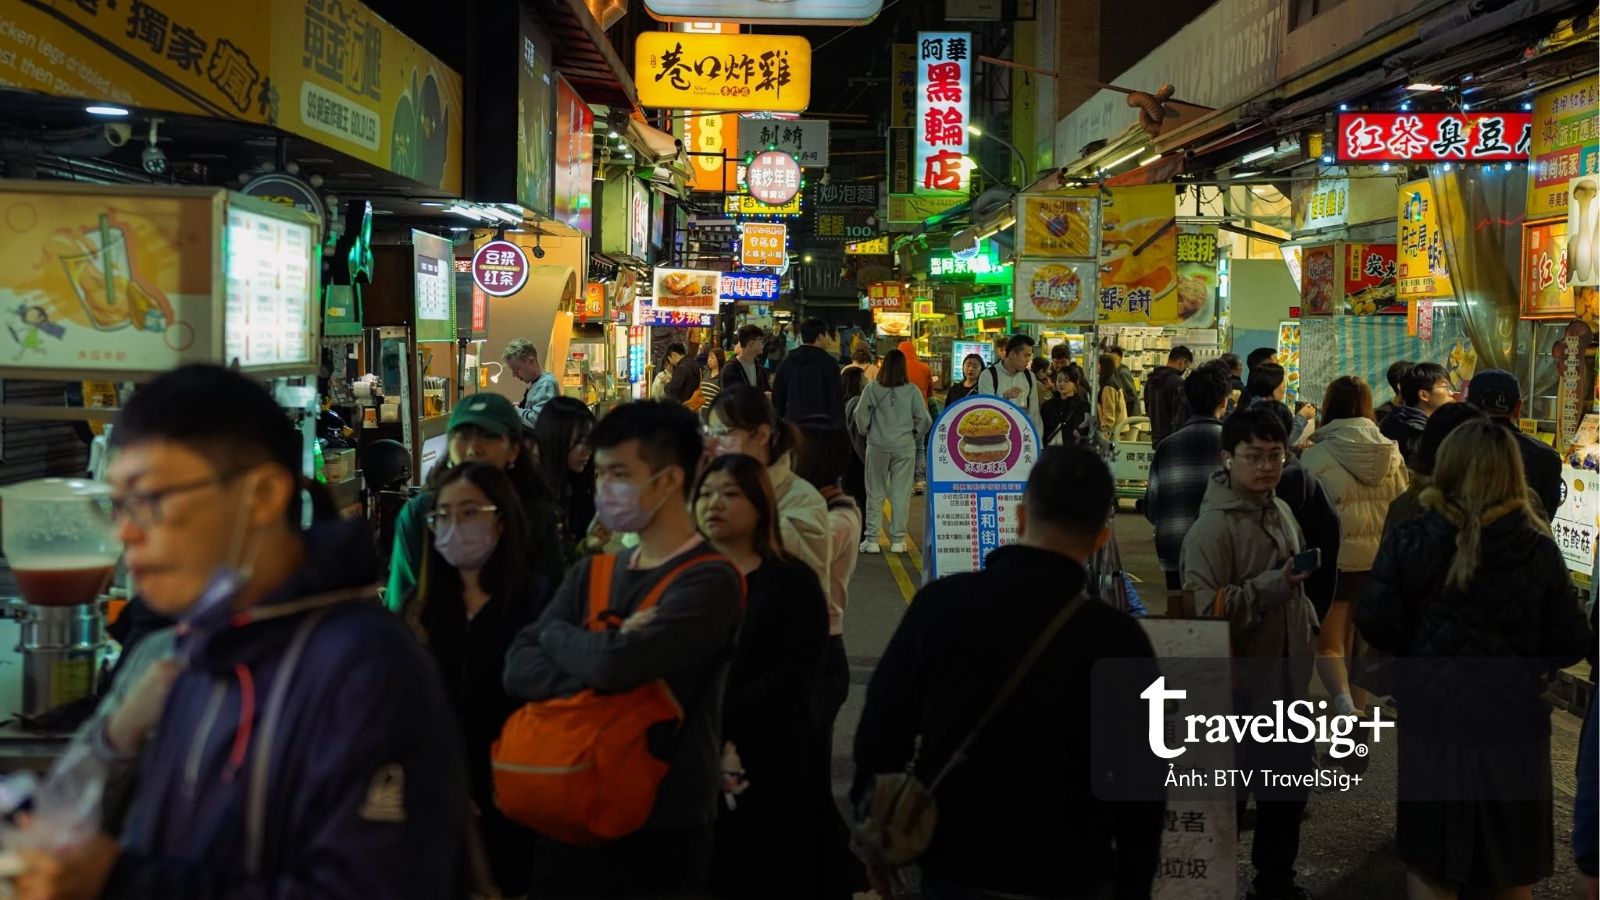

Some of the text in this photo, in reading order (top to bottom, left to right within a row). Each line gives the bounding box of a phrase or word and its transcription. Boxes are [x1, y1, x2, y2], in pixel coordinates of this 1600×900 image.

[921, 37, 968, 61] 阿華
[655, 42, 792, 99] 巷口炸雞
[924, 61, 964, 190] 黑輪店
[750, 167, 797, 188] 辣炒年糕
[845, 225, 872, 237] 100
[1177, 233, 1217, 263] 雞排
